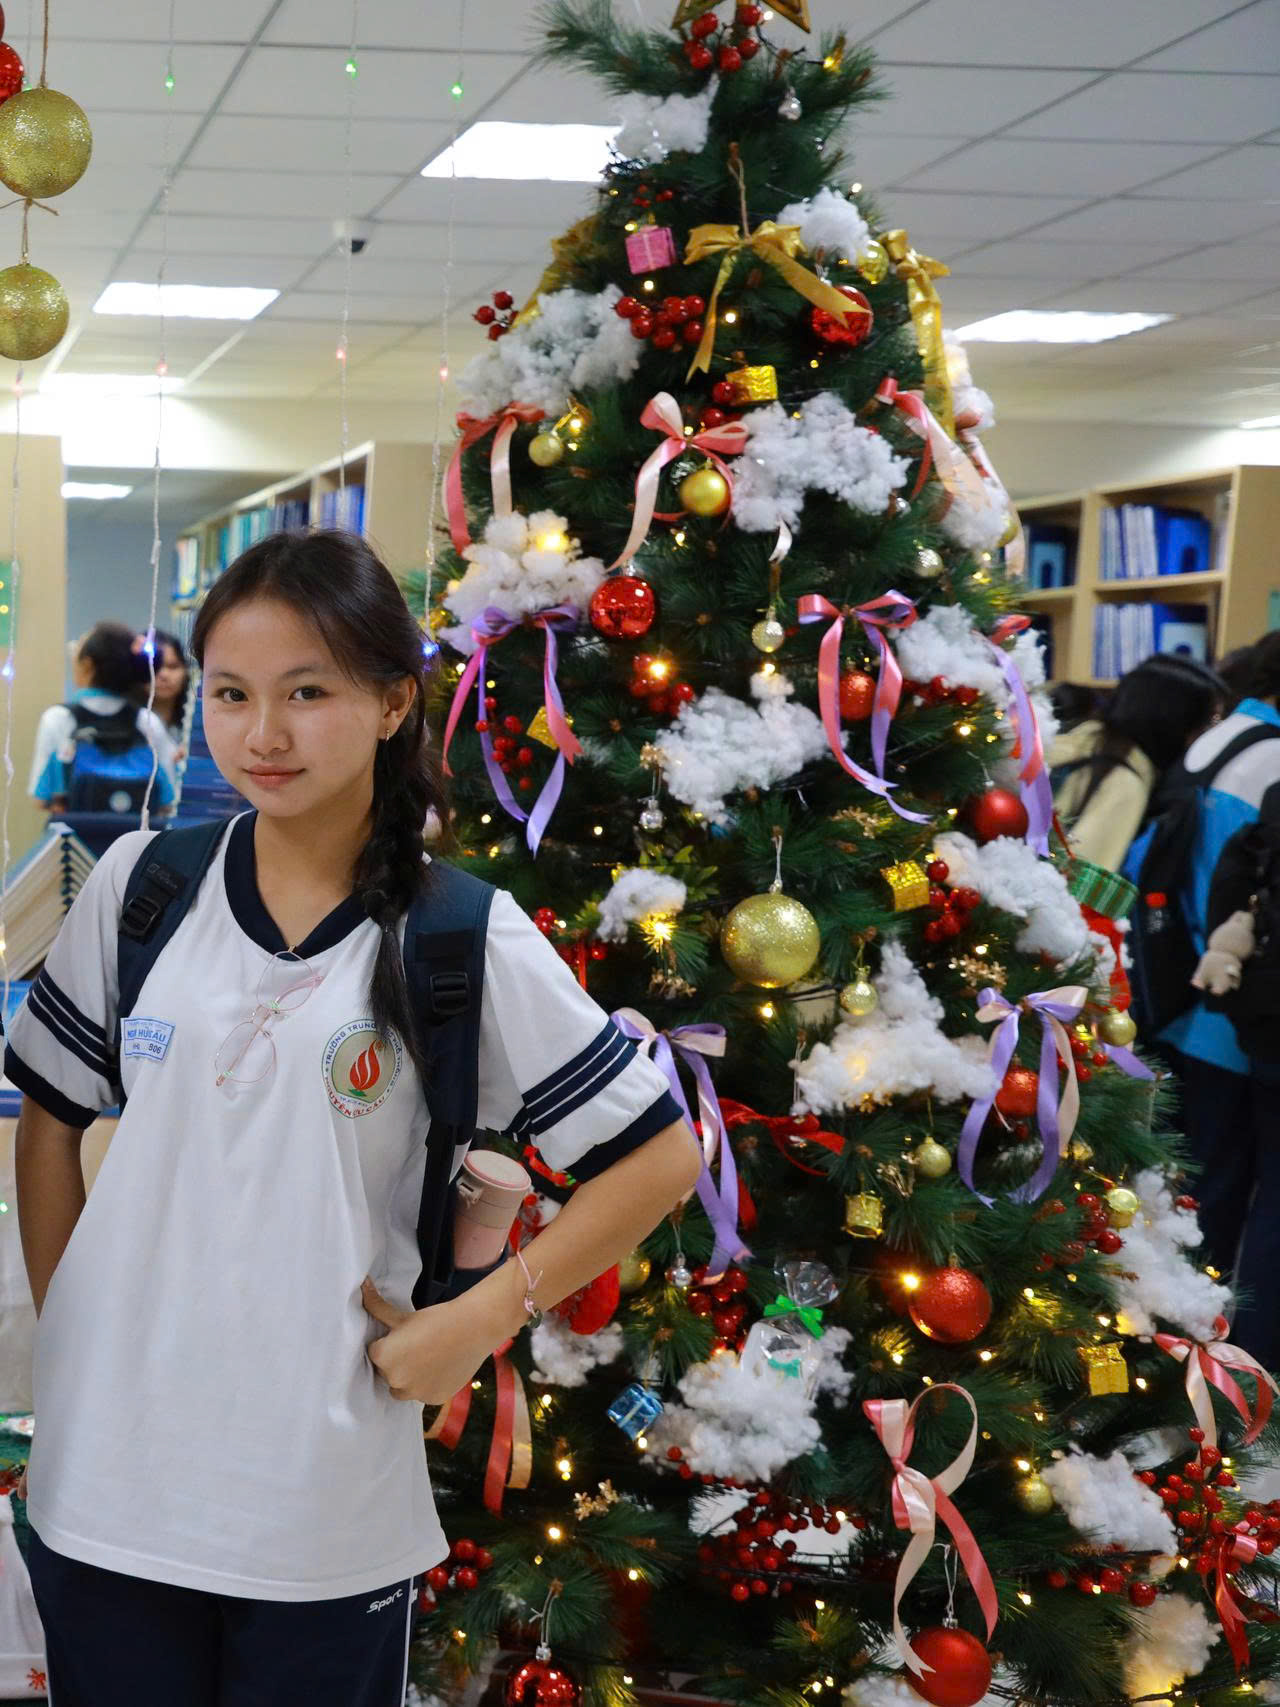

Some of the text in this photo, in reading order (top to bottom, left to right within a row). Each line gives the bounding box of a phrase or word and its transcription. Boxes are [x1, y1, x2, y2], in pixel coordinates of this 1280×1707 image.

[325, 1031, 347, 1065] TRƯỜNG
[348, 1022, 377, 1032] TRUNG
[366, 1588, 404, 1614] Sport
